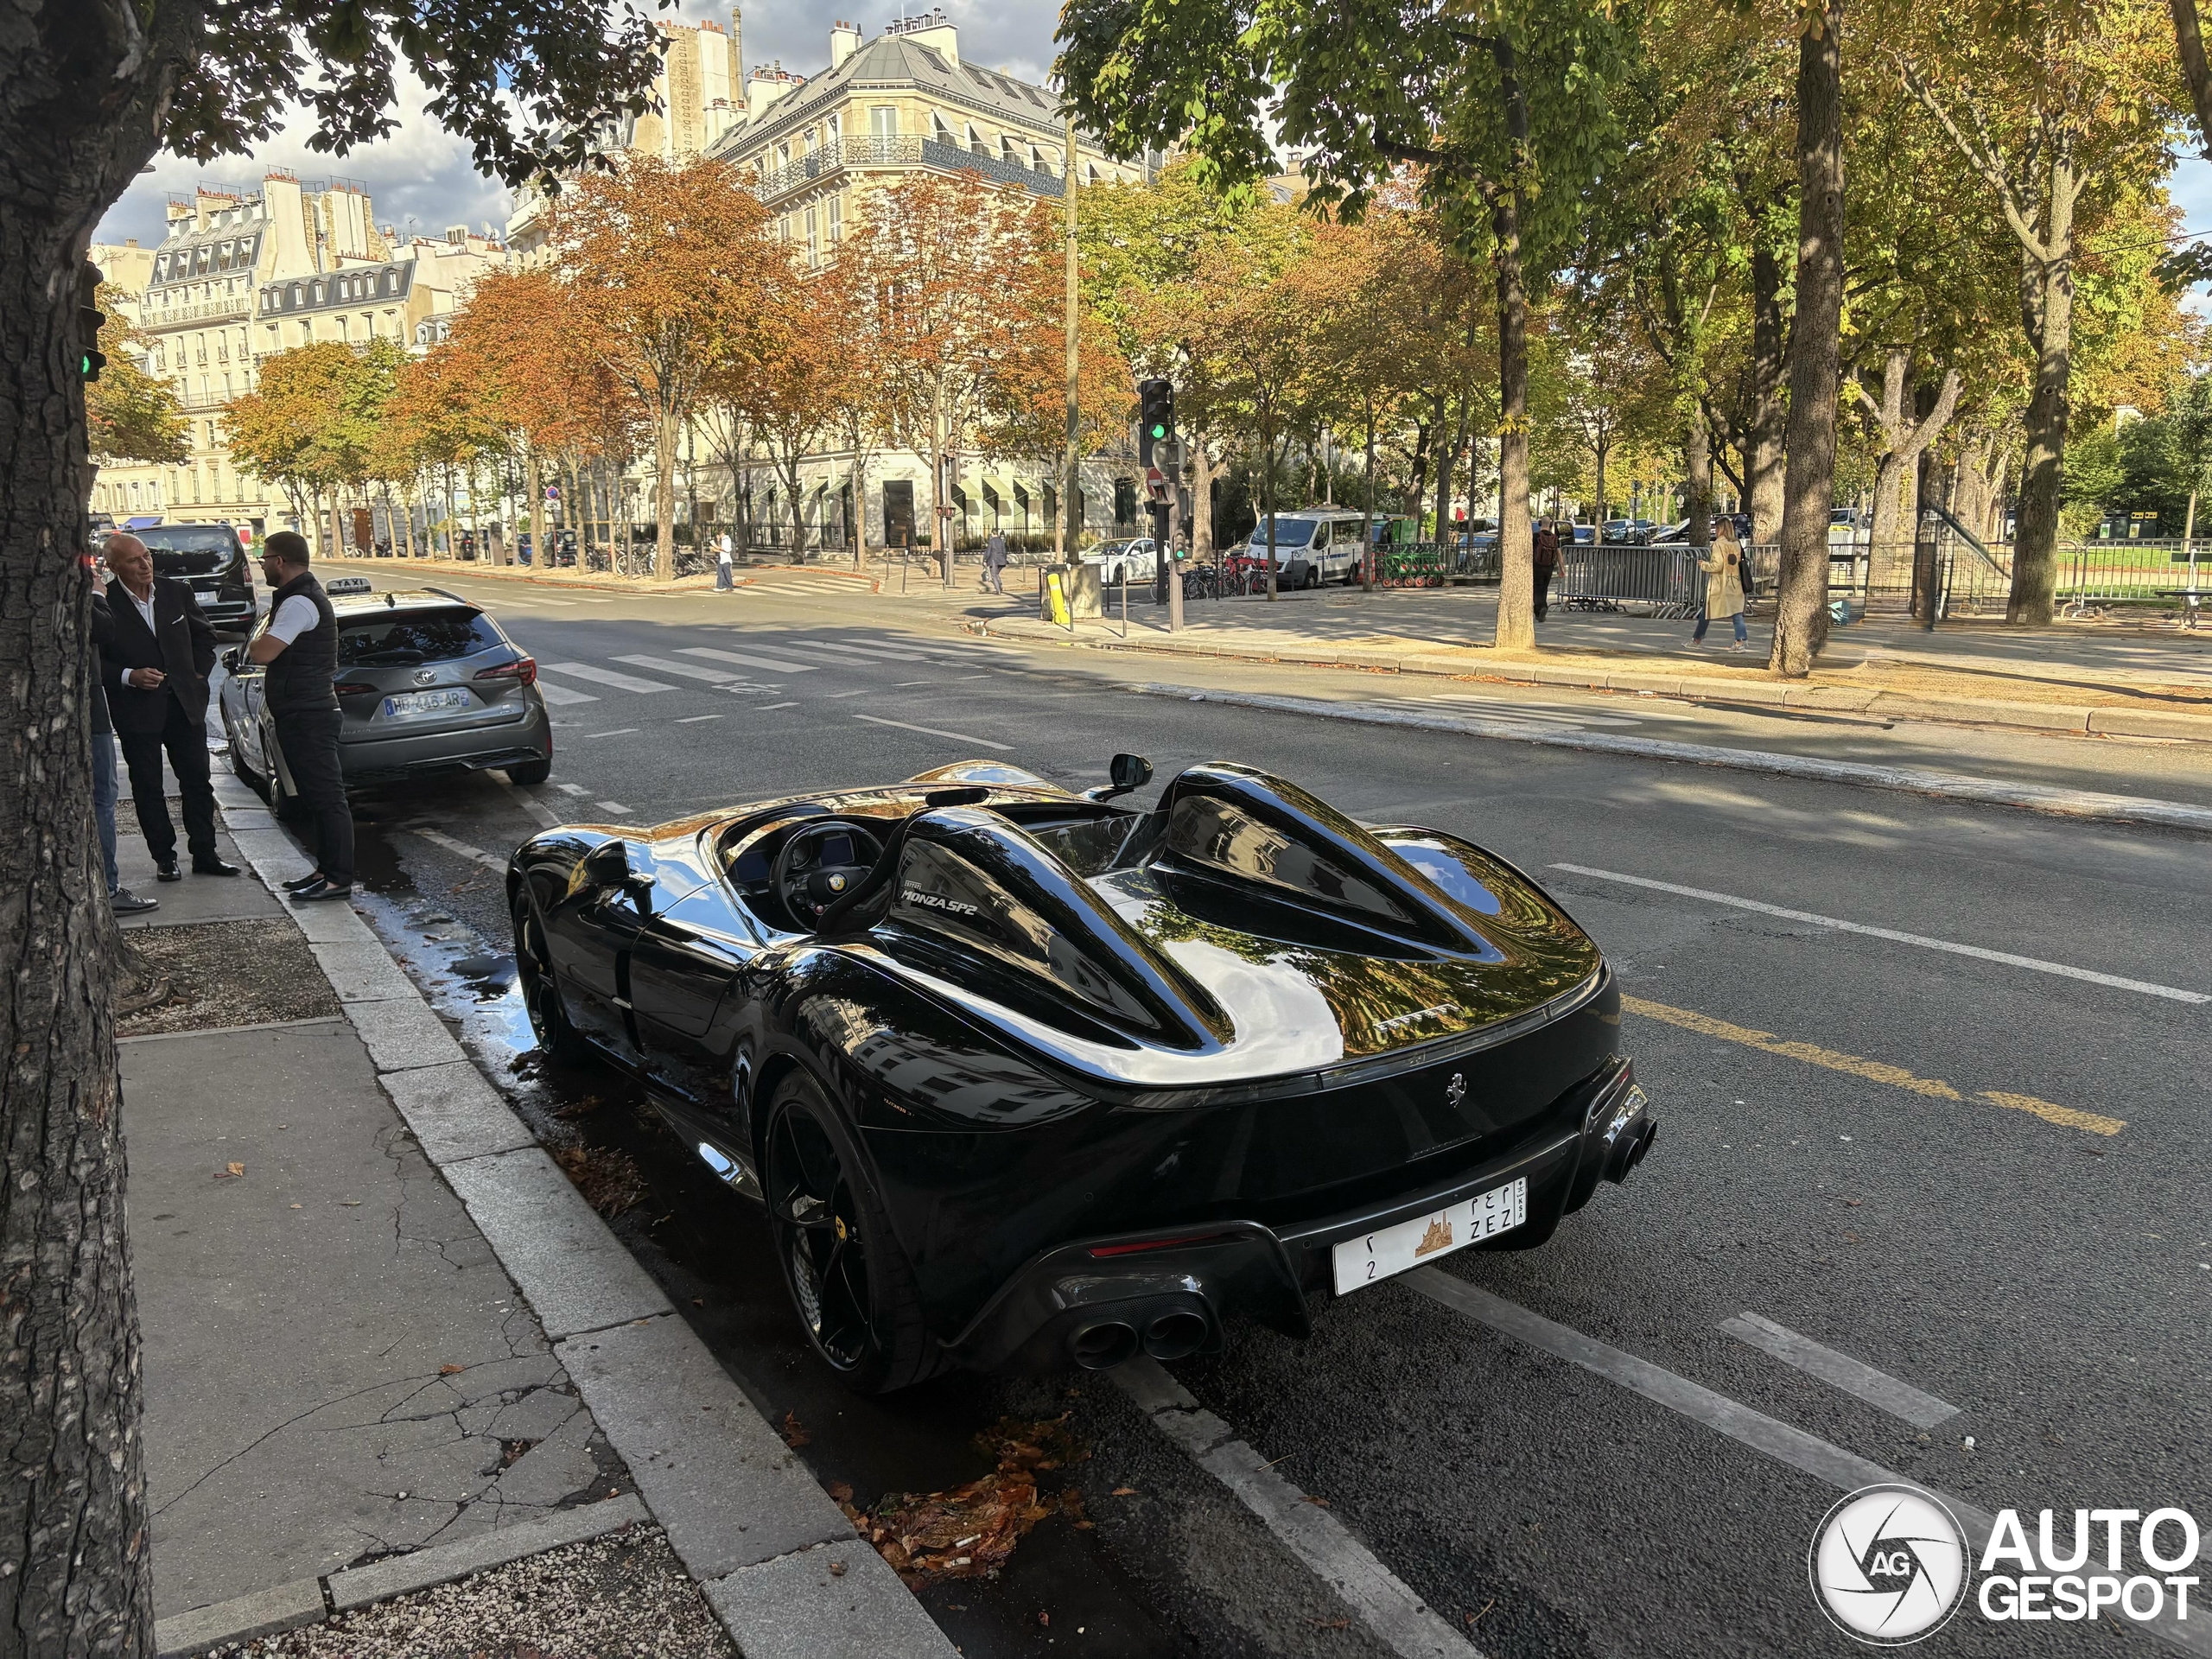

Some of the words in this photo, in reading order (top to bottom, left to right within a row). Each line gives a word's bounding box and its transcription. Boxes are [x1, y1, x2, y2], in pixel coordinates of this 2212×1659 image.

[900, 889, 946, 909] MONZA
[945, 900, 978, 916] SP2
[1366, 1260, 1376, 1281] 2
[1471, 1208, 1511, 1239] ZEZ
